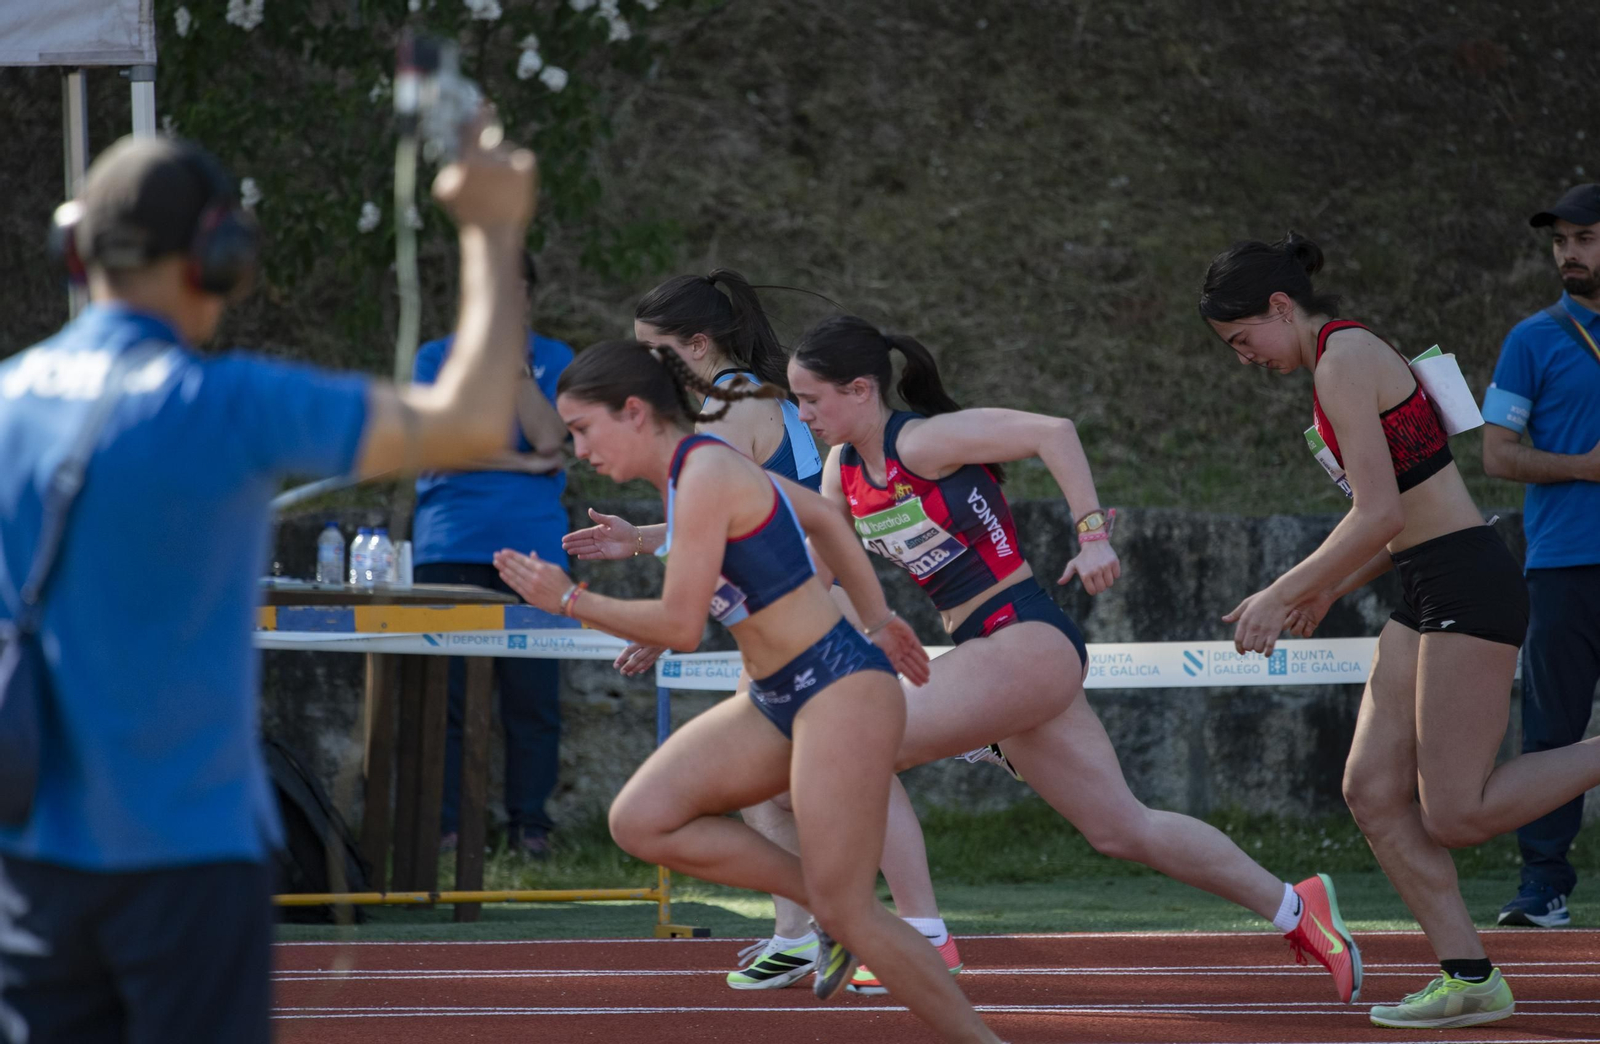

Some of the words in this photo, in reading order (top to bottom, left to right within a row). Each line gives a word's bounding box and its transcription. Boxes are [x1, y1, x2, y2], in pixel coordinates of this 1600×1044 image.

[869, 512, 911, 533] Iberdrola
[452, 635, 504, 646] DEPORTE
[532, 637, 576, 648] XUNTA
[1090, 653, 1133, 664] XUNTA
[1291, 650, 1335, 661] XUNTA
[685, 667, 701, 677] DE
[705, 667, 742, 678] GALIC
[1089, 666, 1106, 677] DE
[1109, 665, 1160, 676] GALICIA
[1213, 664, 1261, 675] GALEGO
[1291, 662, 1308, 673] DE
[1311, 661, 1362, 673] GALICIA
